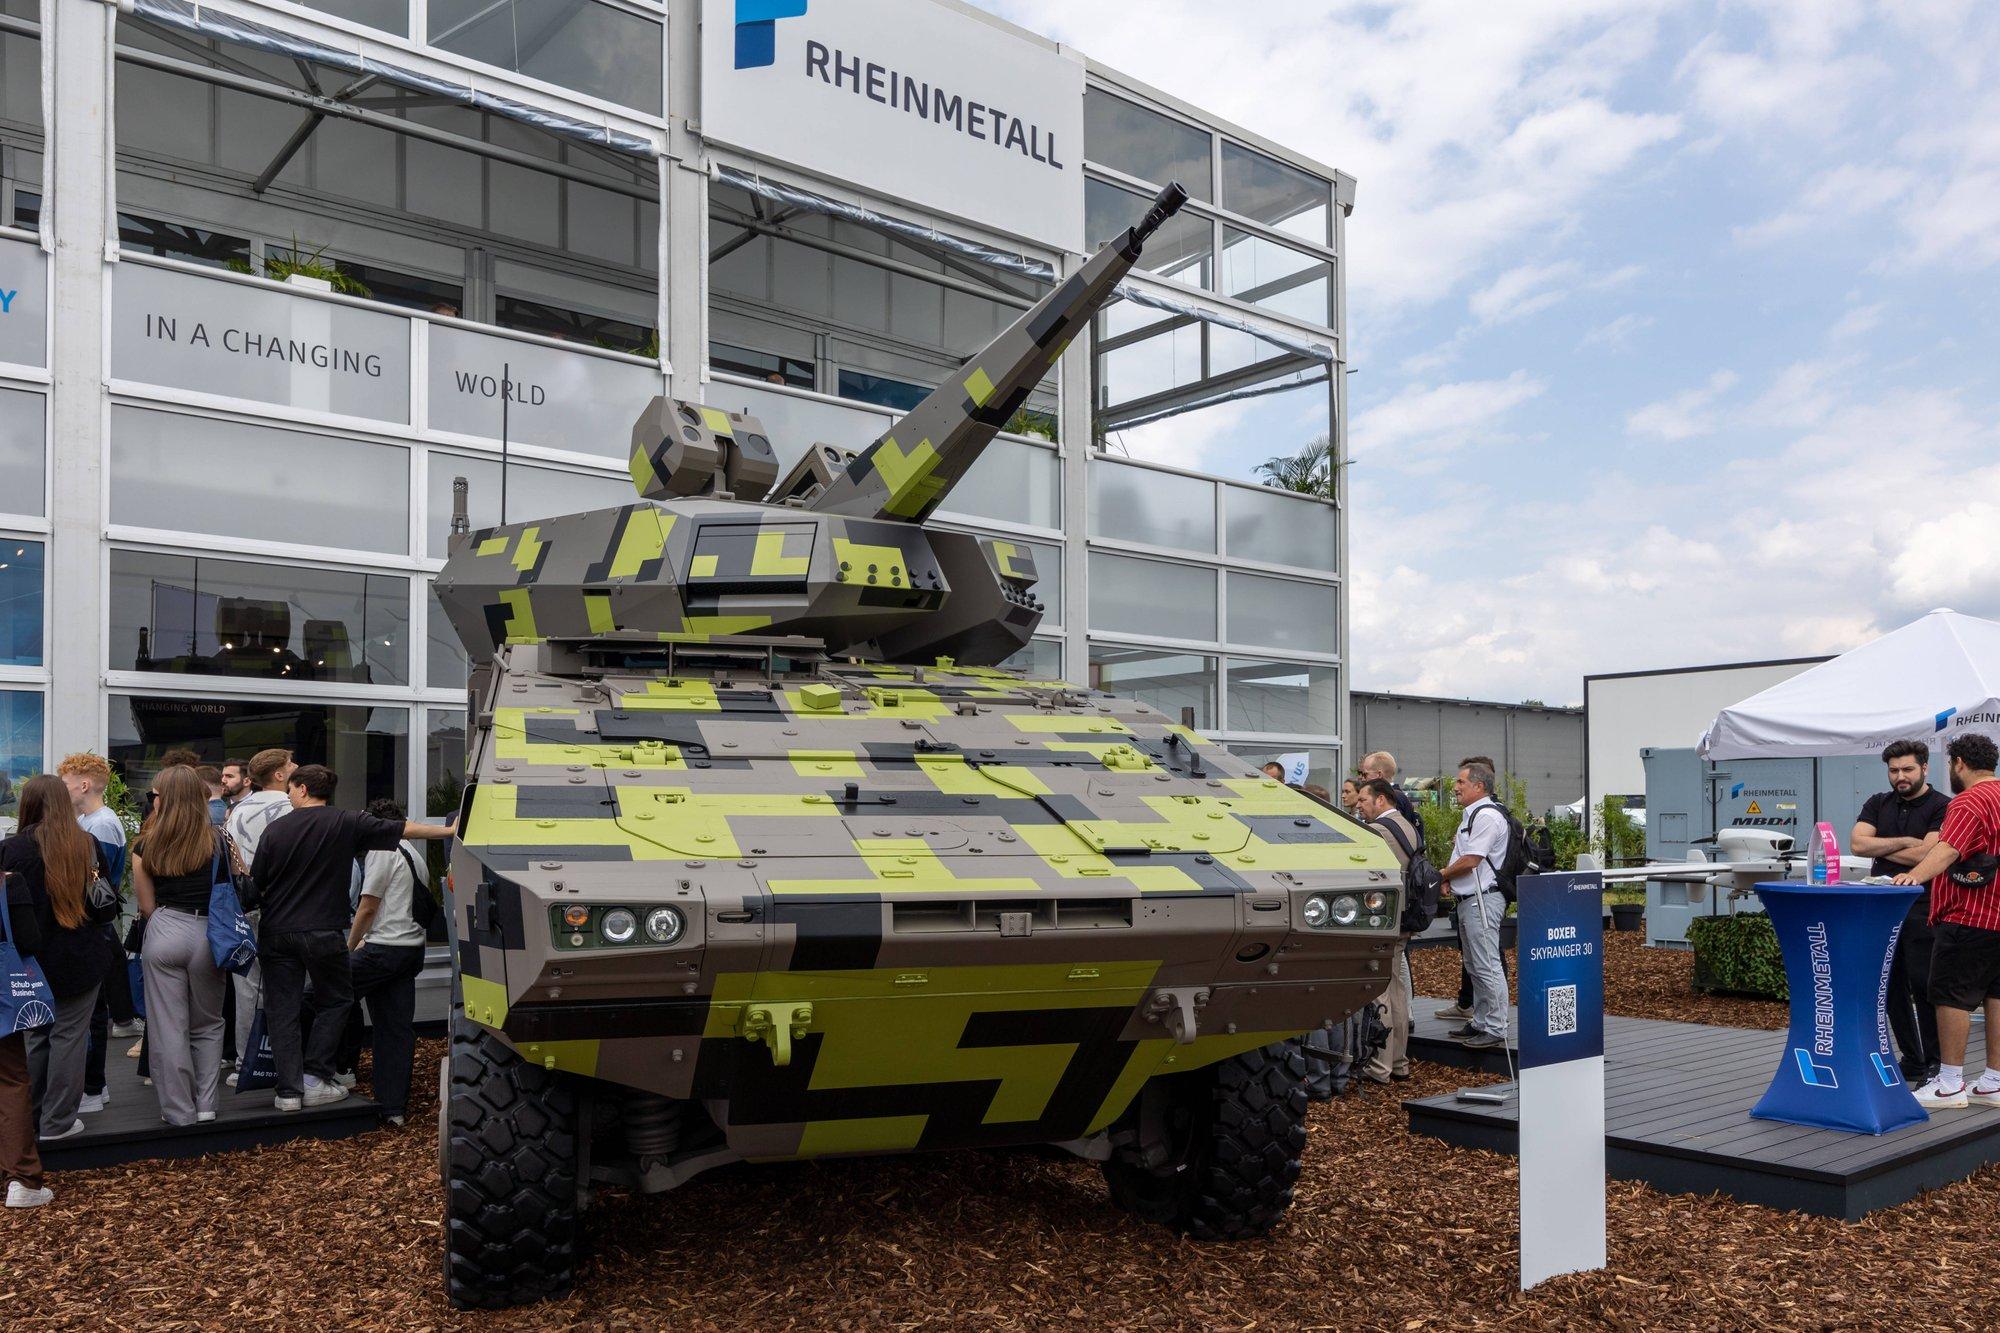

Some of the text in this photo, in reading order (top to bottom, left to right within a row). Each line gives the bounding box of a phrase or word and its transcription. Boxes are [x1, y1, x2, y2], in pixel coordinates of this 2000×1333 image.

[806, 39, 1063, 170] RHEINMETALL
[146, 313, 381, 377] IN A CHANGING
[455, 370, 545, 406] WORLD
[190, 703, 226, 714] WORLD
[1956, 712, 2000, 726] RHEIN
[1743, 789, 1798, 797] RHEINMETALL
[1731, 817, 1798, 826] MBDA
[1547, 926, 1576, 940] BOXER
[1530, 942, 1593, 961] SKYRANGER 30
[1807, 922, 1834, 1056] RHEINMETALL
[1877, 921, 1903, 1055] RHEINMETALL
